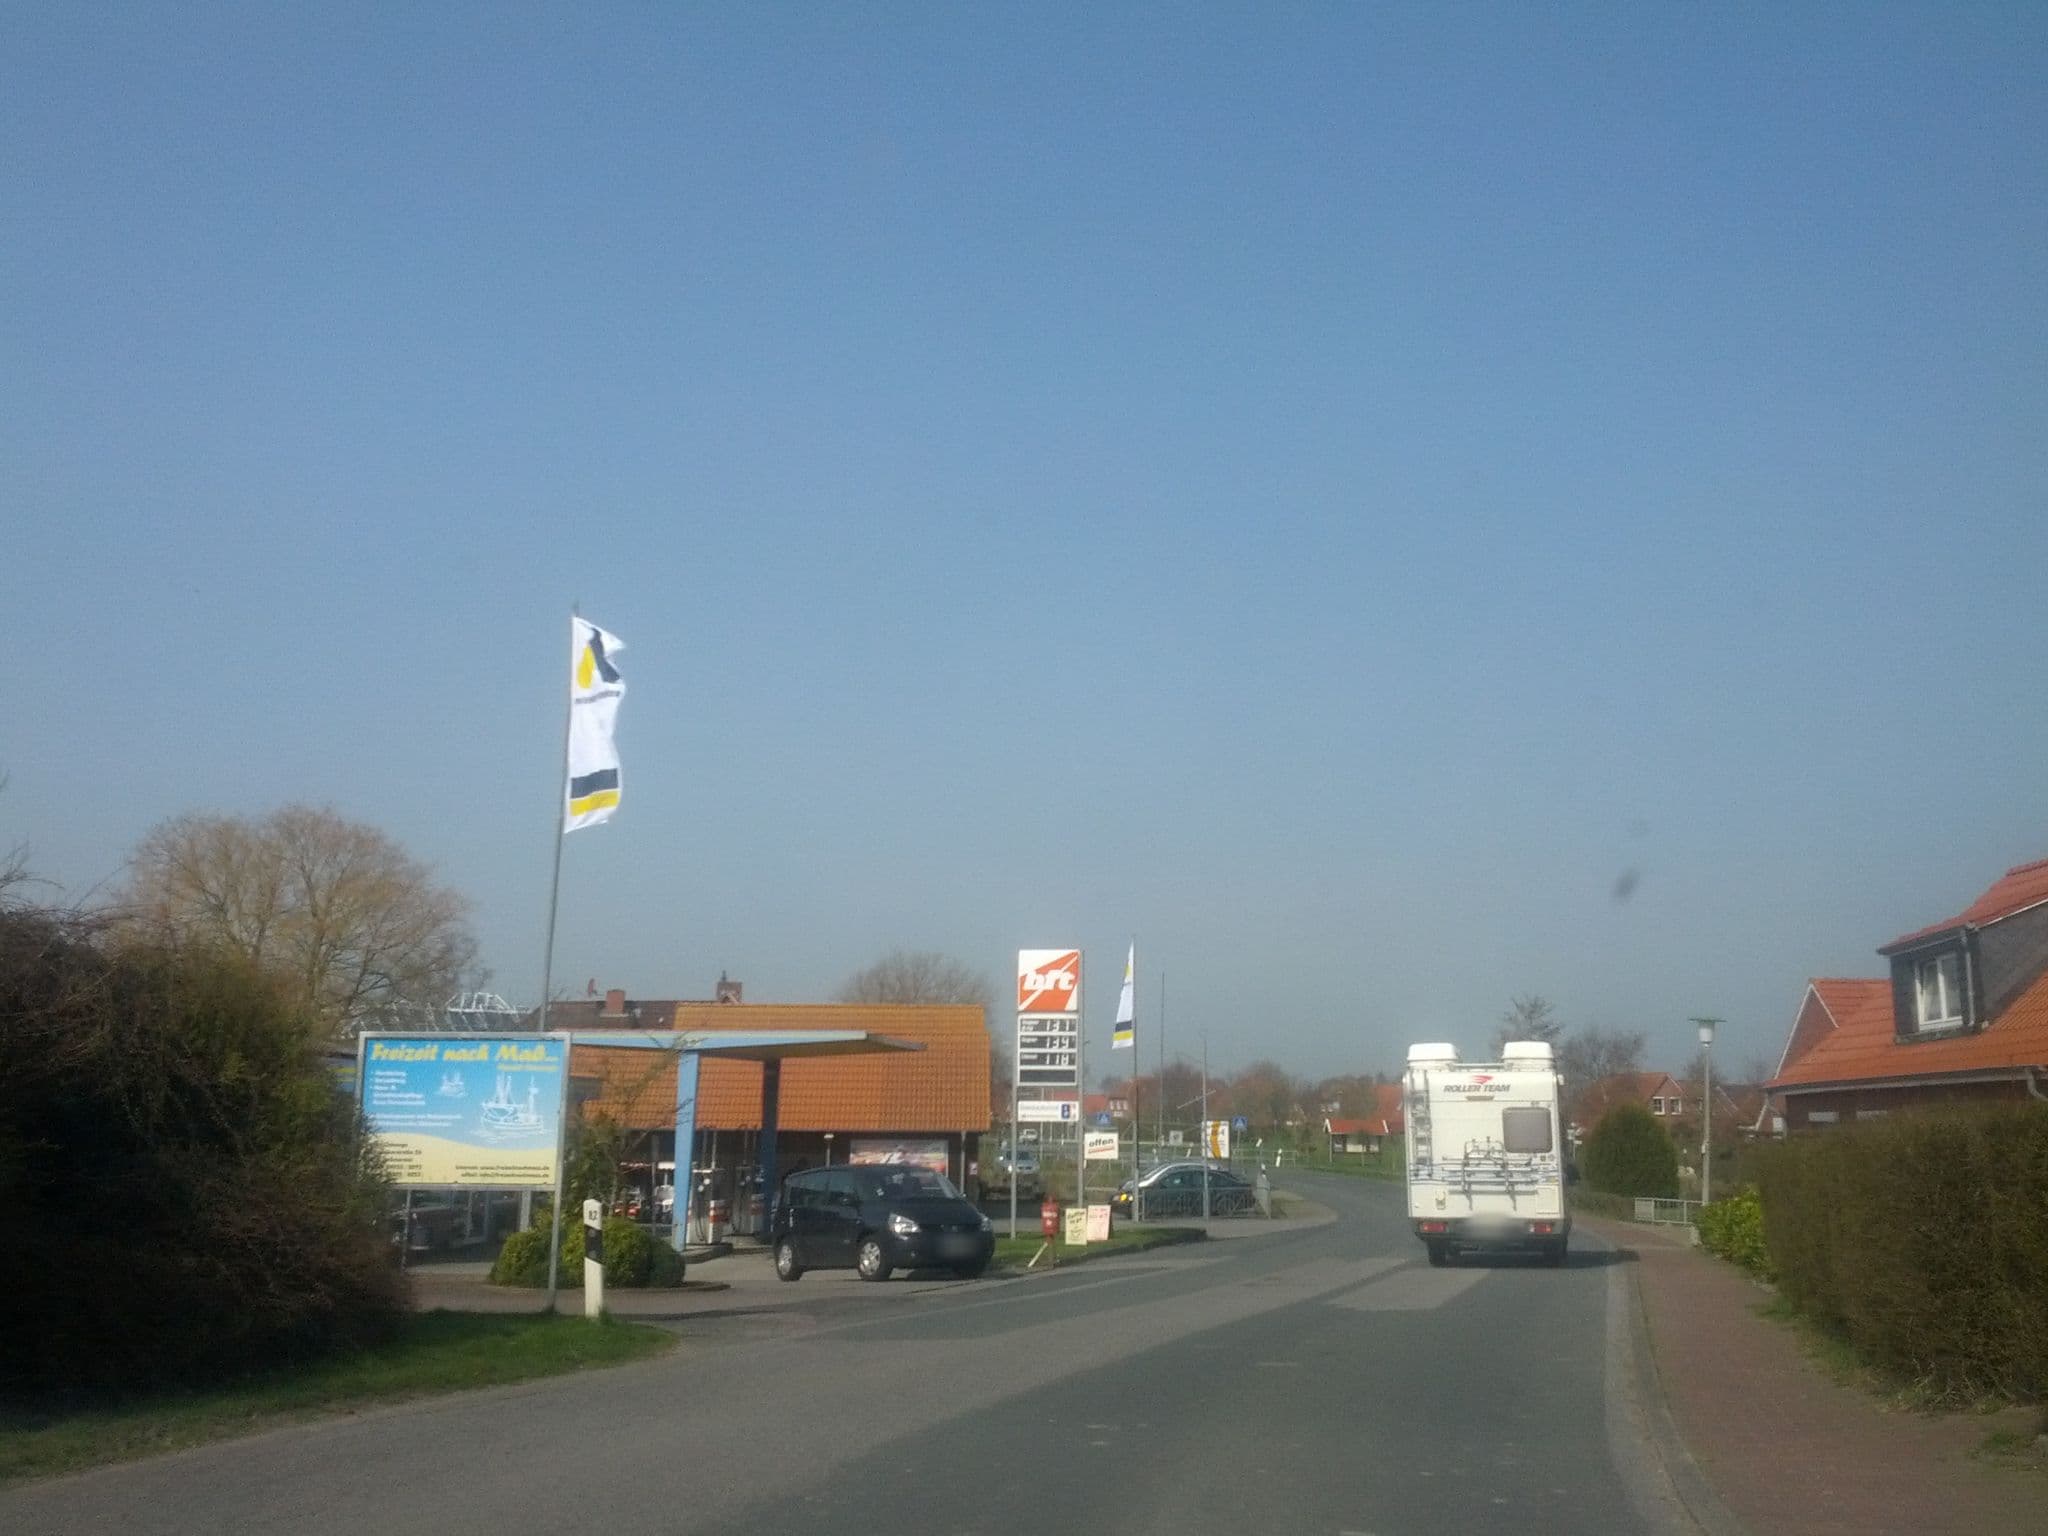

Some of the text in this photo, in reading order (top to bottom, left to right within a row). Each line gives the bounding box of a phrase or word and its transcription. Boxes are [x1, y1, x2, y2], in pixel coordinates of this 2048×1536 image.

[1023, 969, 1075, 991] bft
[1443, 1084, 1511, 1092] ROLLER TEAM
